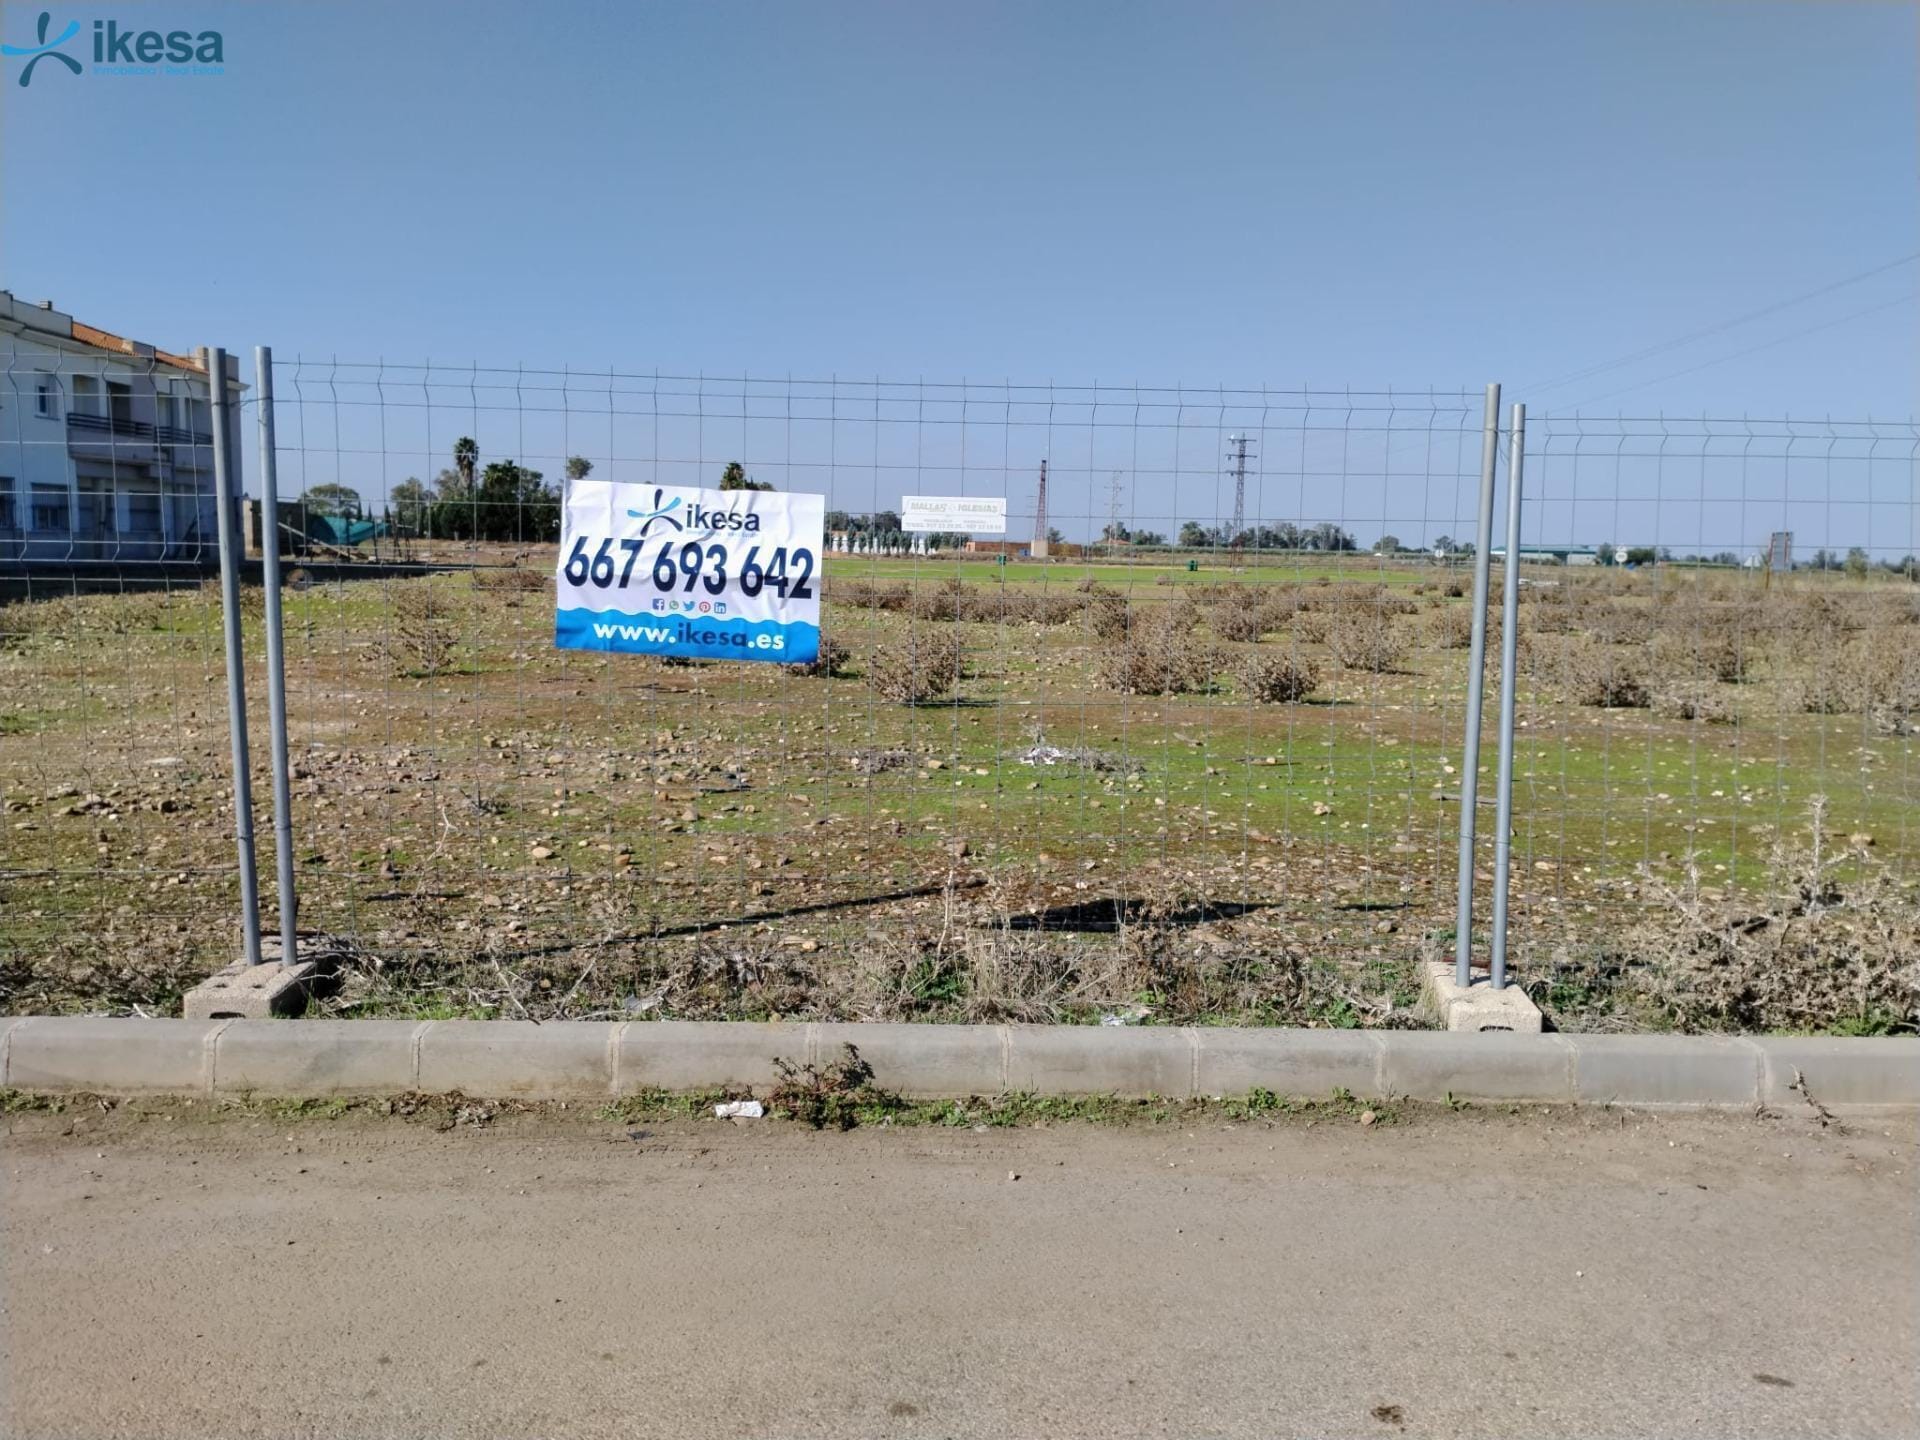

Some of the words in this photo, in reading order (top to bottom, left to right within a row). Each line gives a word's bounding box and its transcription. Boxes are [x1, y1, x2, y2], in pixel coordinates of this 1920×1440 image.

[686, 503, 760, 532] ikesa
[565, 535, 645, 589] 667
[652, 541, 728, 595] 693
[740, 546, 814, 599] 642
[592, 622, 785, 650] www.ikesa.es
